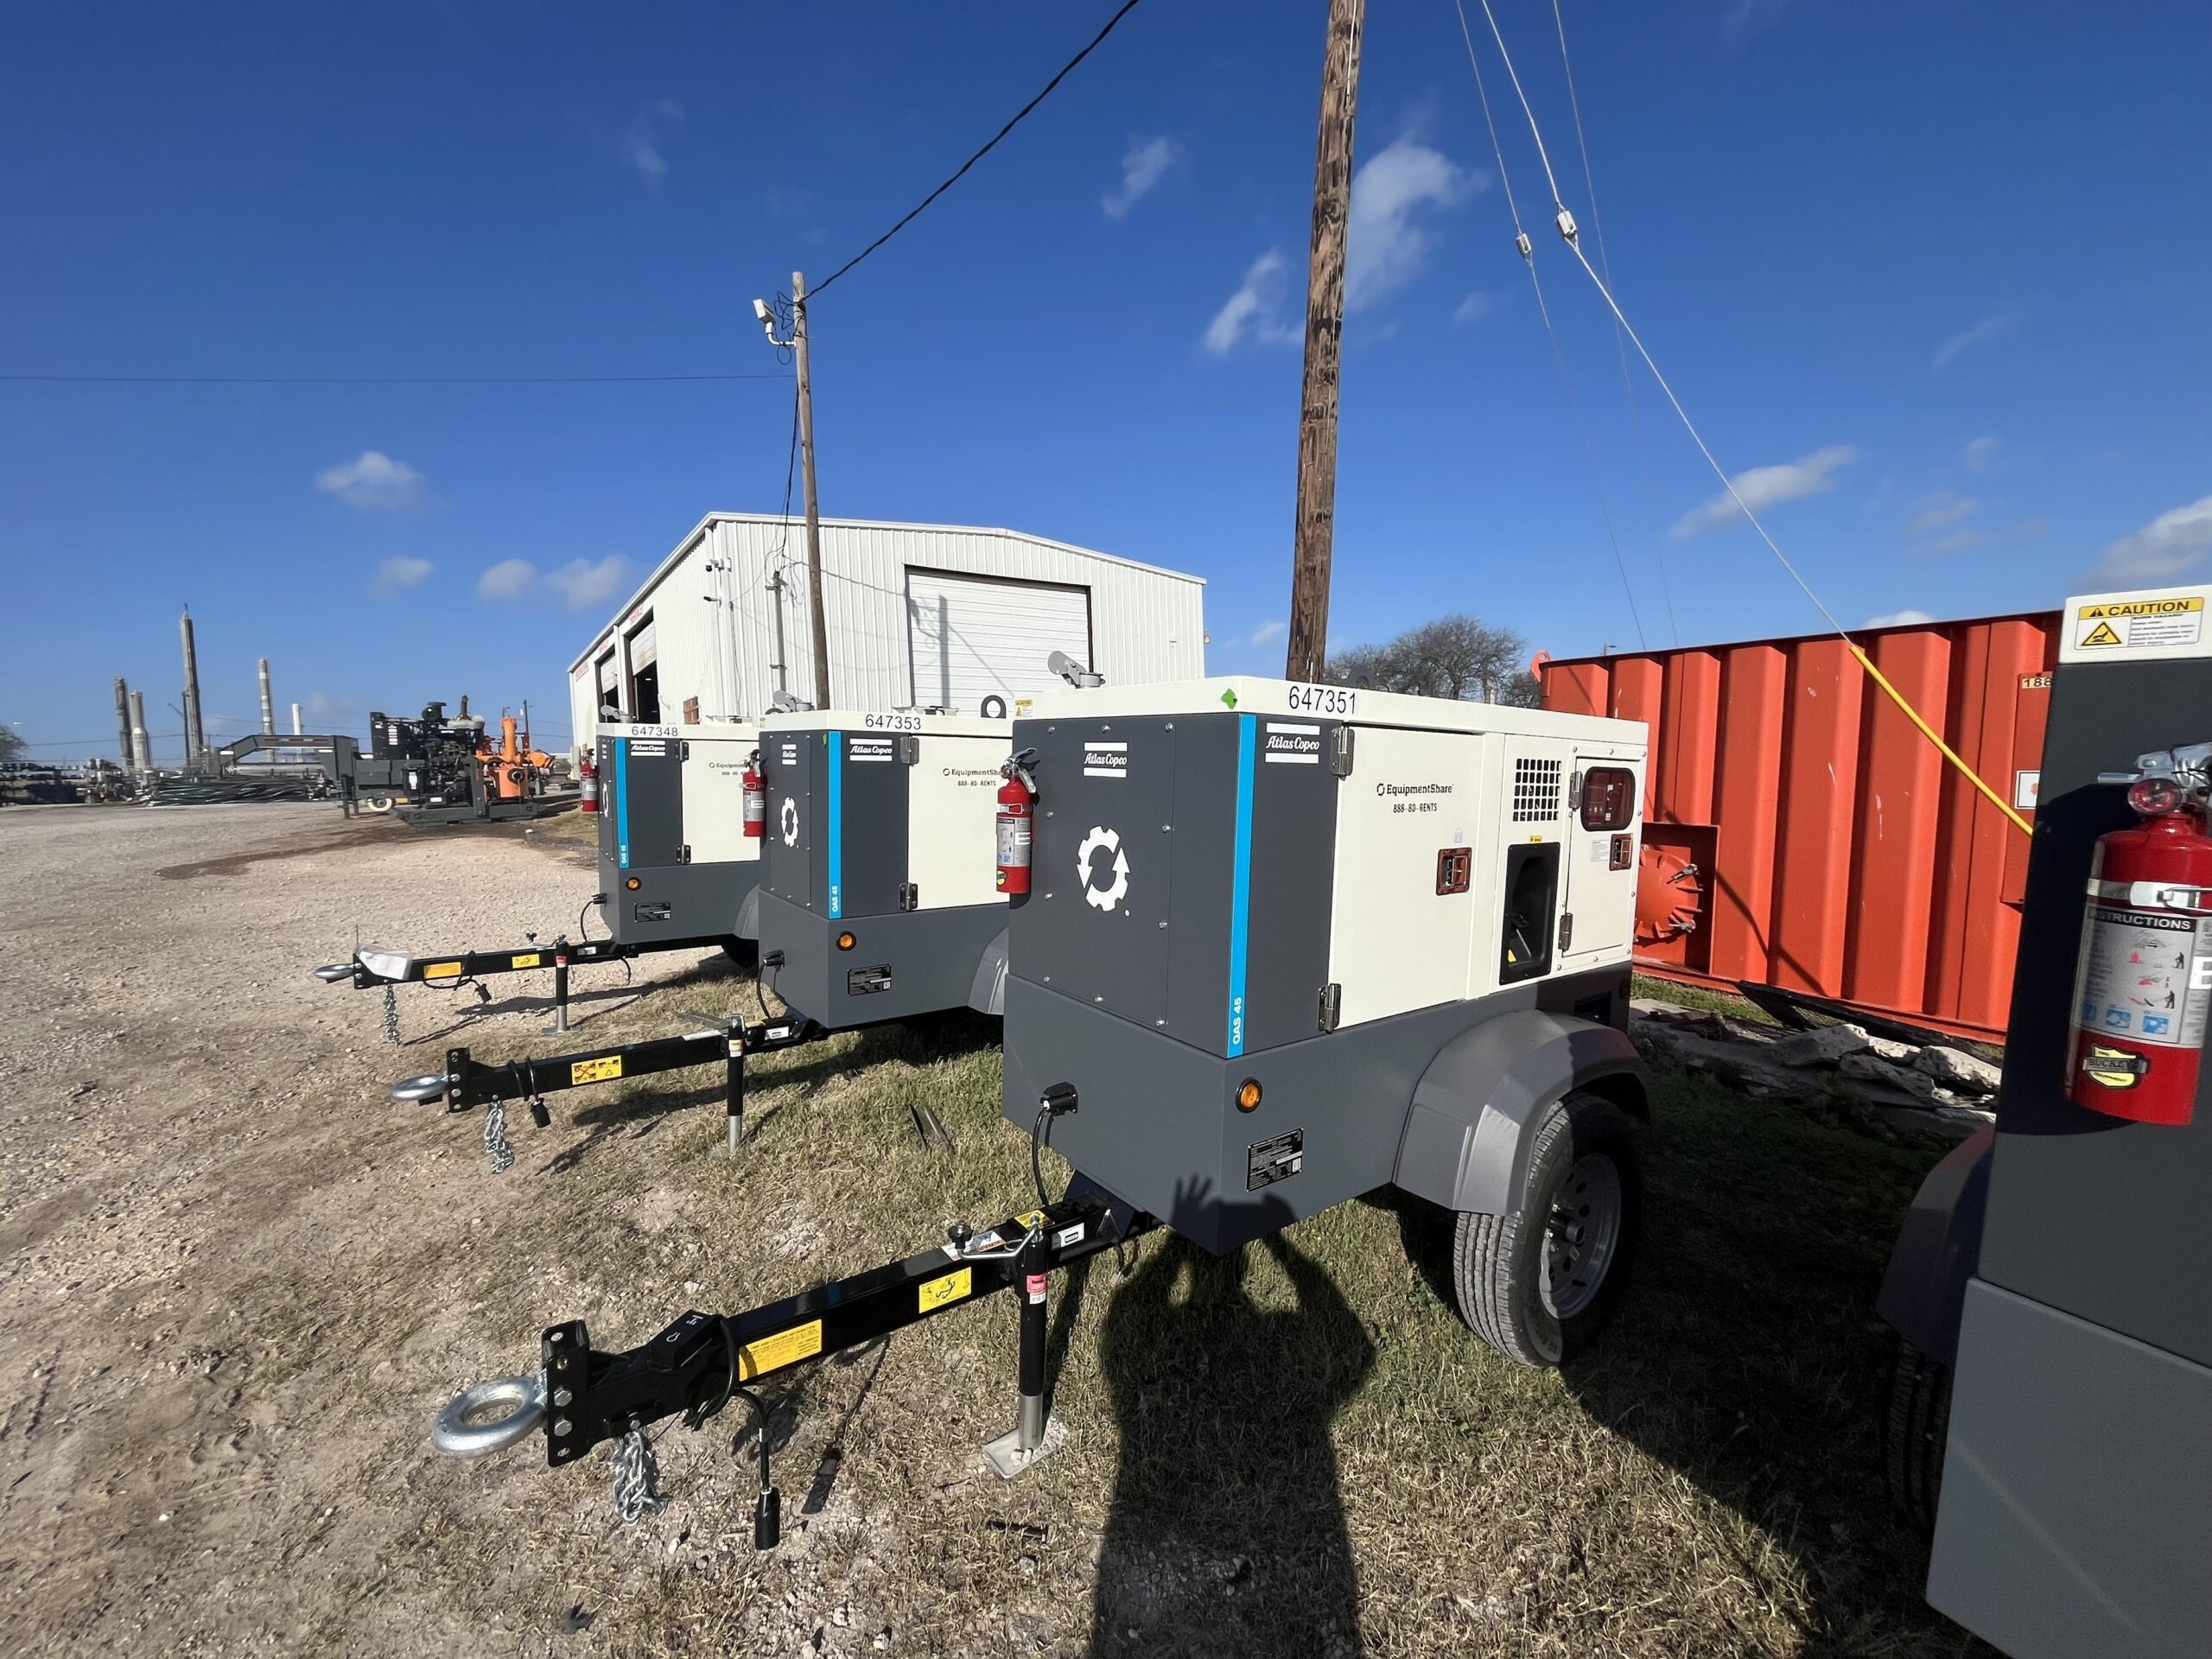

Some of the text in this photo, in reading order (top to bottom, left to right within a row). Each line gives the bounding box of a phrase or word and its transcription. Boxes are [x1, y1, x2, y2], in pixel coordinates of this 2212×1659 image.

[2107, 601, 2190, 616] CAUTION
[1288, 685, 1357, 715] 647351
[865, 714, 922, 731] 647353
[631, 725, 679, 737] 647348
[849, 745, 893, 755] Atlas Copco
[1266, 734, 1320, 753] Atlas Copco
[1084, 752, 1128, 767] Atlas Copco
[1386, 783, 1452, 797] EquipmentShare
[2093, 912, 2192, 931] STRUCTIONS
[1232, 996, 1243, 1046] QAS 45
